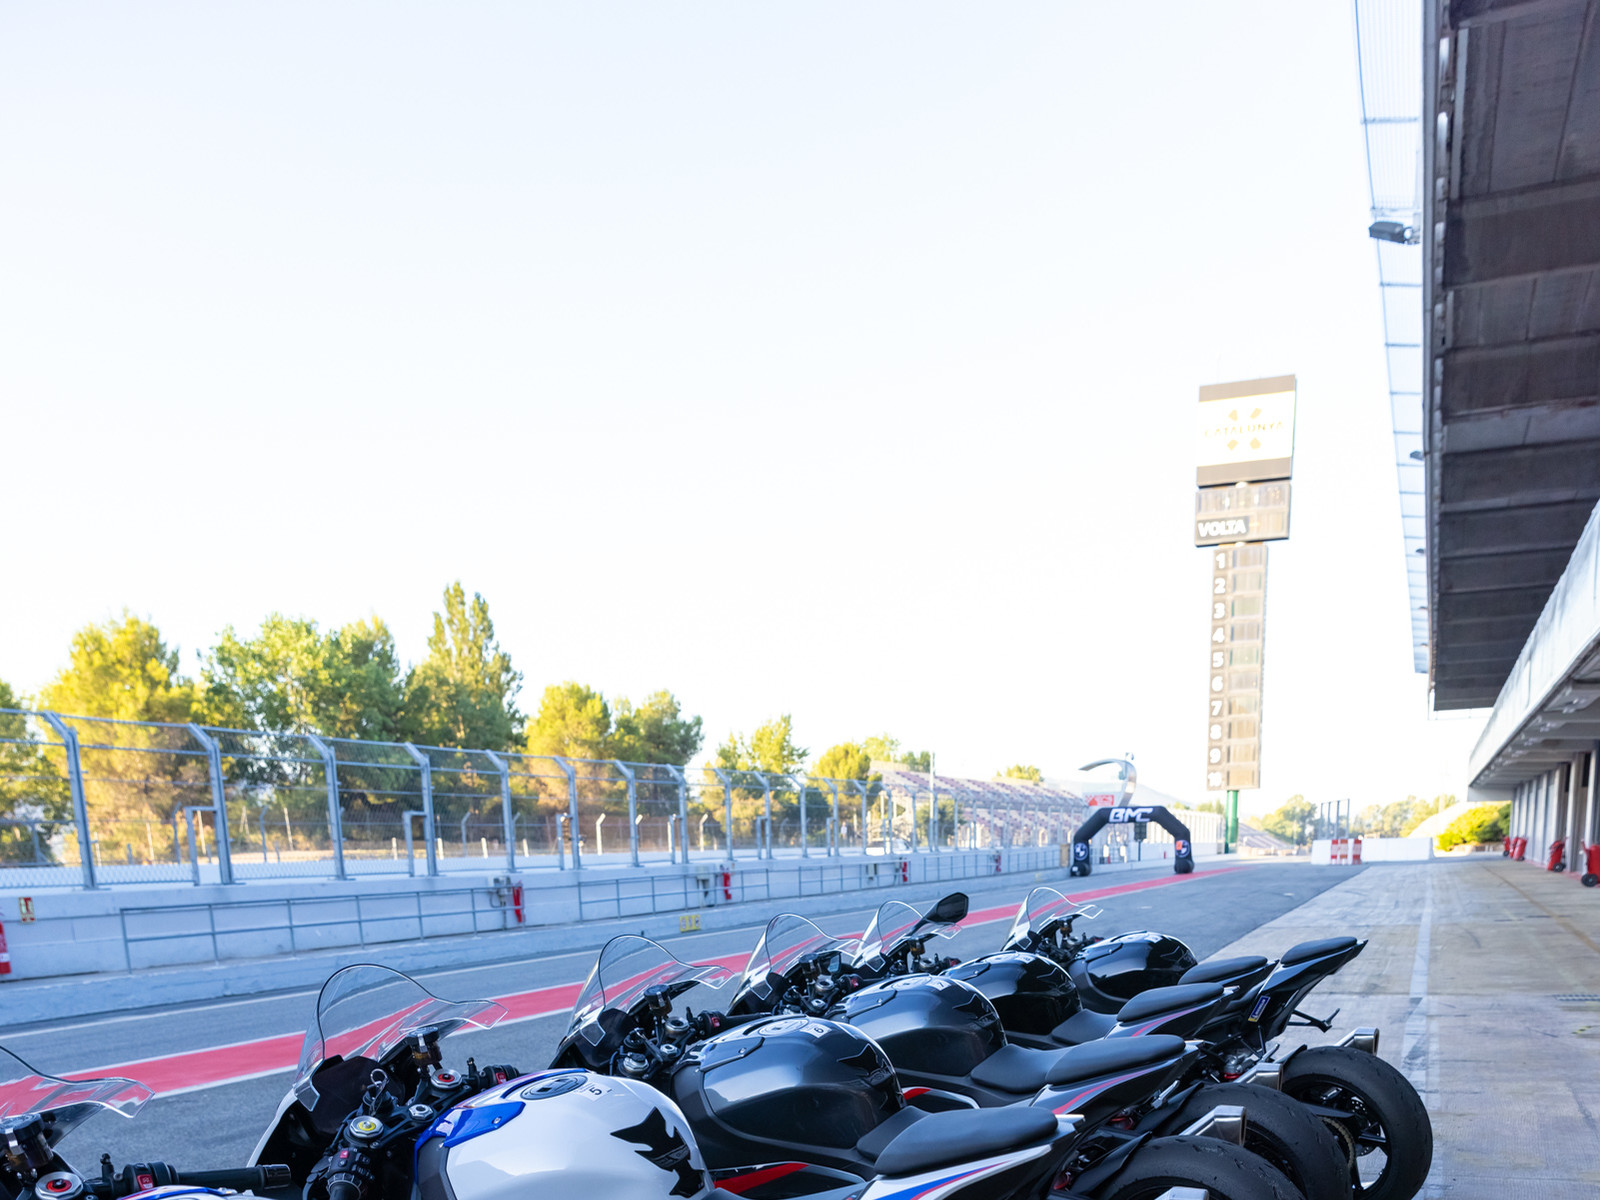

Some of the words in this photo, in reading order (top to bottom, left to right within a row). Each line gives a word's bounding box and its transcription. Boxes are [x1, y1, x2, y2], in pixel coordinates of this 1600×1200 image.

[1198, 519, 1247, 537] VOLTA
[1215, 552, 1226, 569] 1
[1214, 577, 1226, 594] 2
[1214, 602, 1225, 619] 3
[1212, 627, 1225, 643] 4
[1212, 651, 1224, 668] 5
[1211, 675, 1223, 692] 6
[1210, 700, 1223, 716] 7
[1209, 724, 1222, 740] 8
[1209, 747, 1221, 764] 9
[589, 1086, 602, 1096] 5
